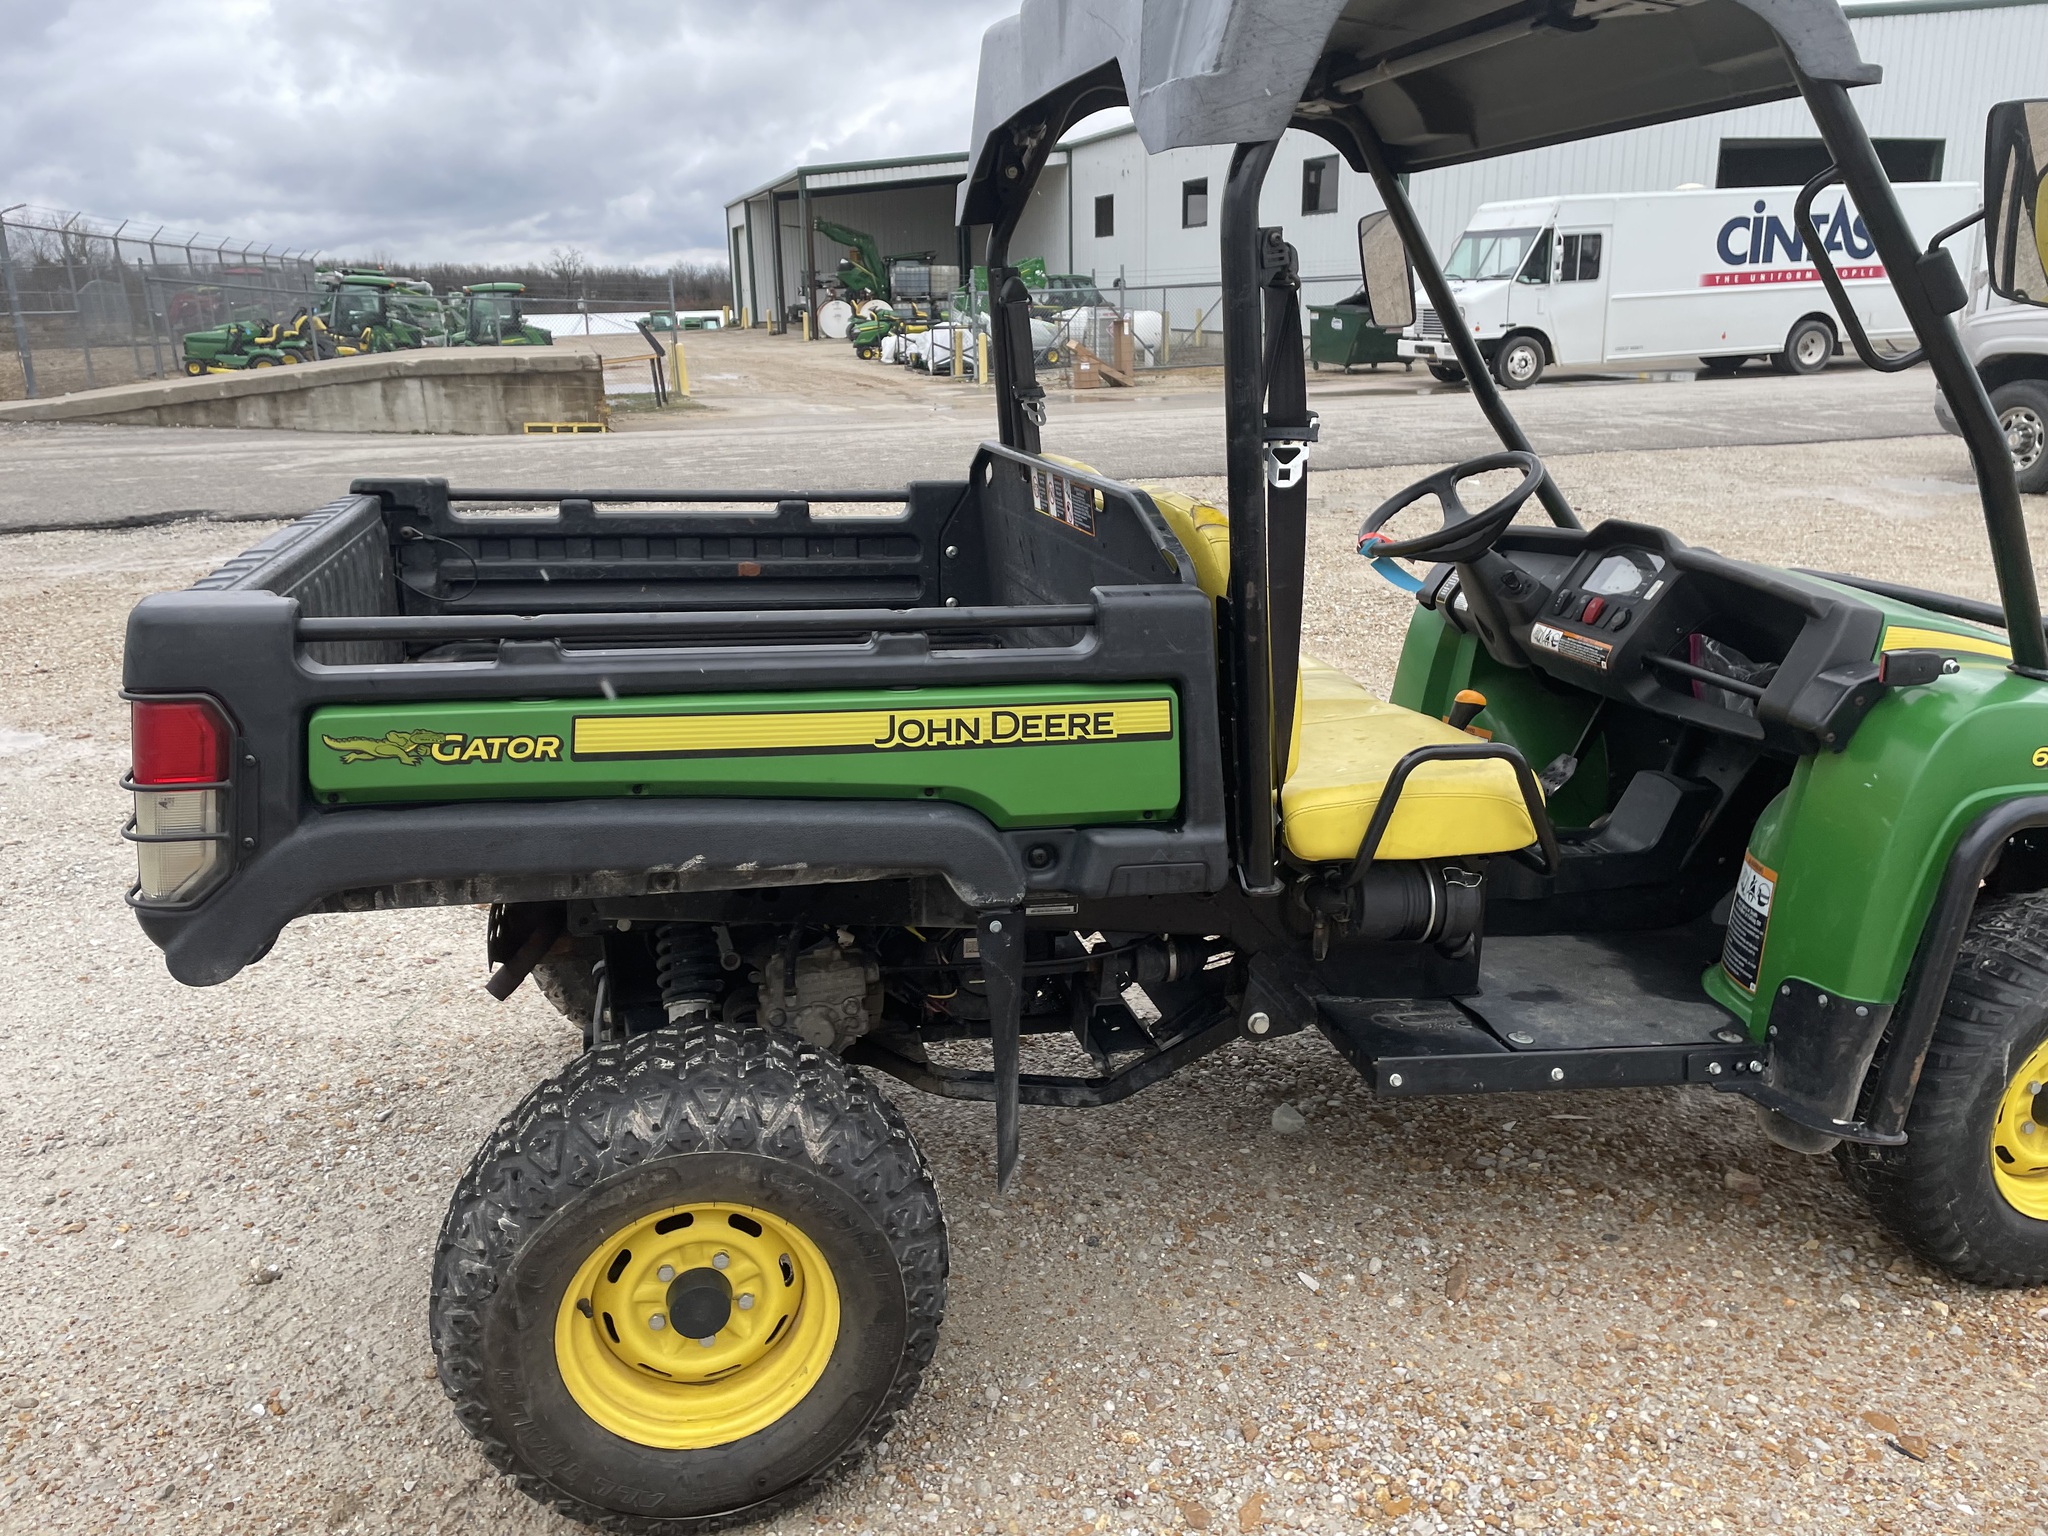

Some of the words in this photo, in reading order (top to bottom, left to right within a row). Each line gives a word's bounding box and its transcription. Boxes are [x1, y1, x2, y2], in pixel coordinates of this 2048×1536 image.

[1715, 275, 1739, 285] THE
[1750, 270, 1813, 284] UNIFORM
[874, 714, 982, 748] JOHN
[991, 711, 1117, 743] DEERE
[431, 734, 562, 763] GATOR
